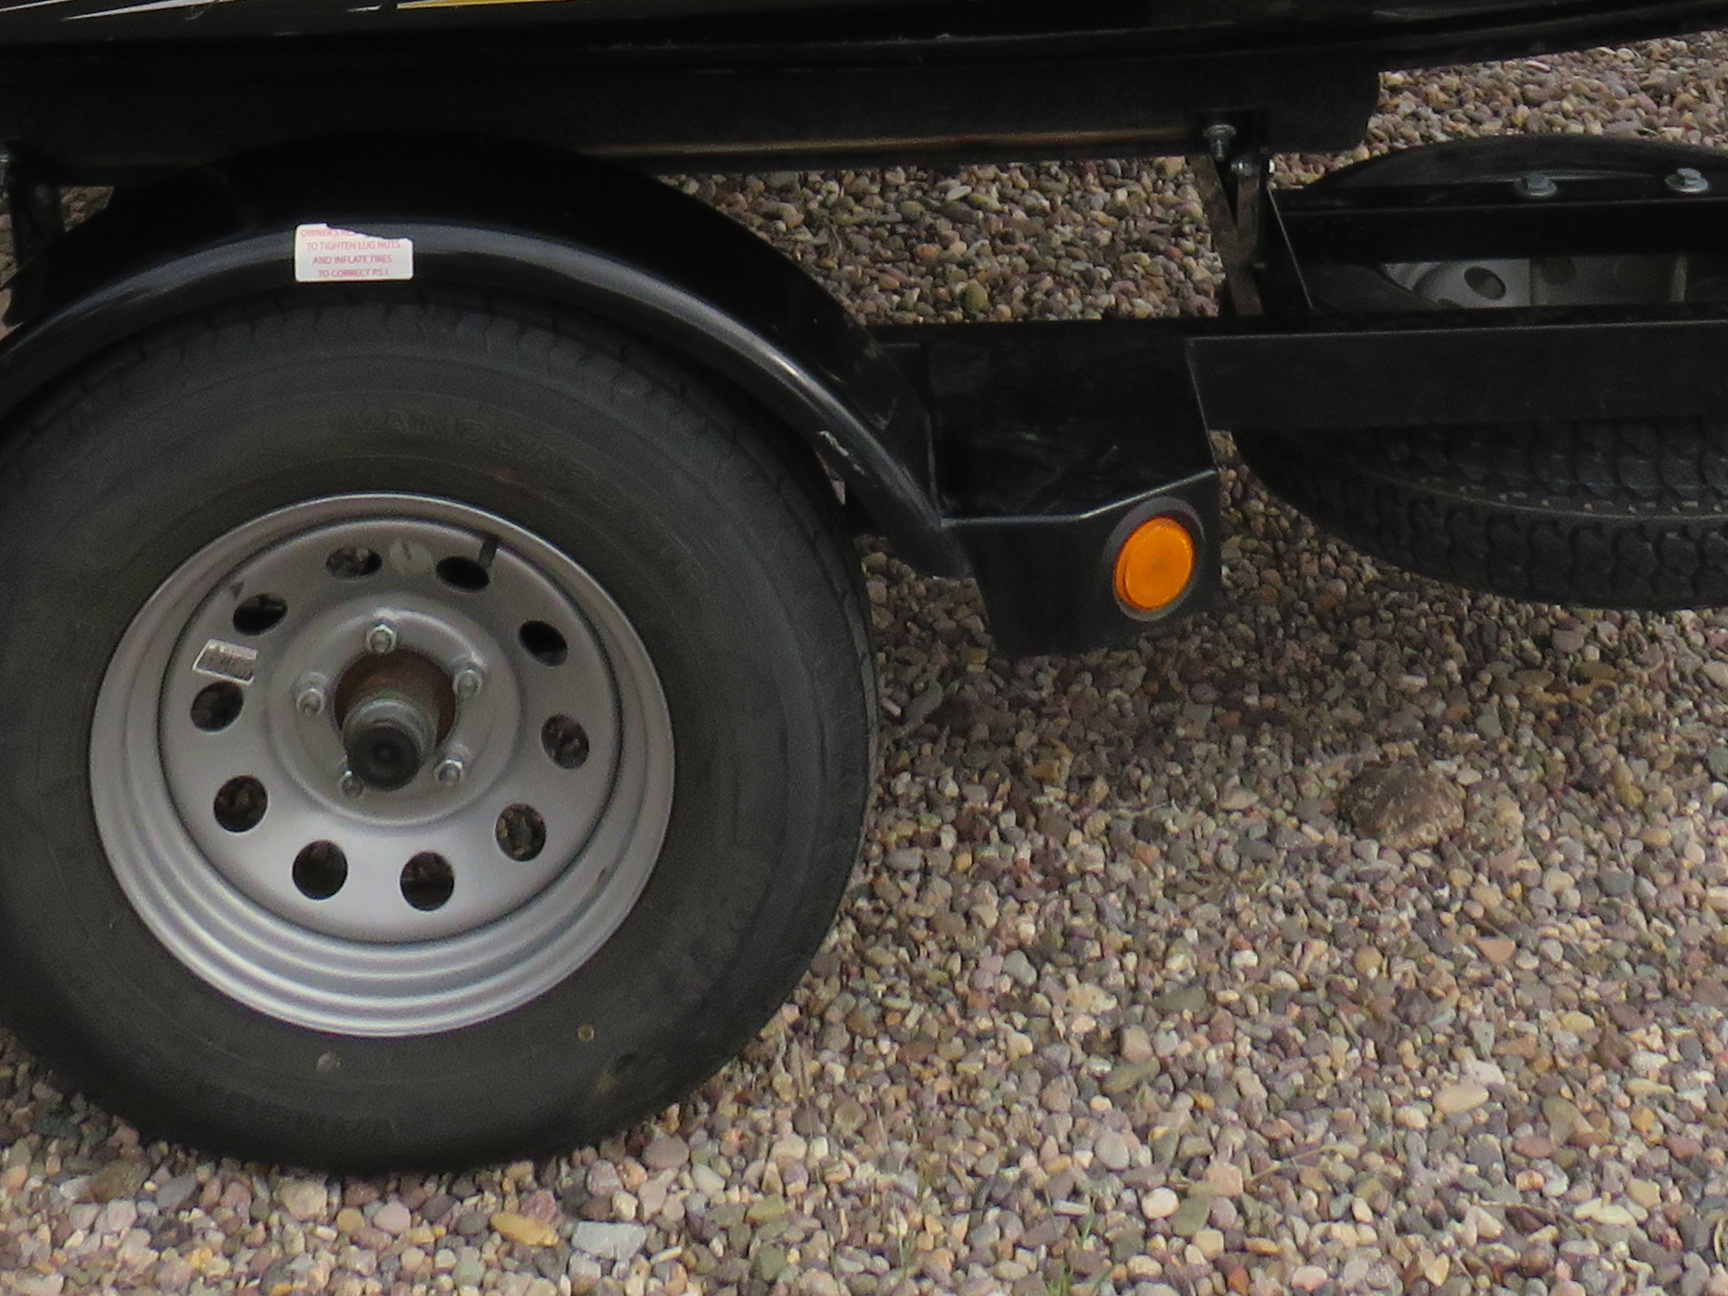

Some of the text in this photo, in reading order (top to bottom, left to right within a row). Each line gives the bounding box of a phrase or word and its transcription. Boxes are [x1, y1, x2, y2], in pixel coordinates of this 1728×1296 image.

[306, 240, 401, 251] TO TIGHTEN LUG NUTS
[312, 254, 393, 265] AND INFLATE TIRES
[318, 270, 330, 278] TO
[332, 269, 371, 278] CORRECT
